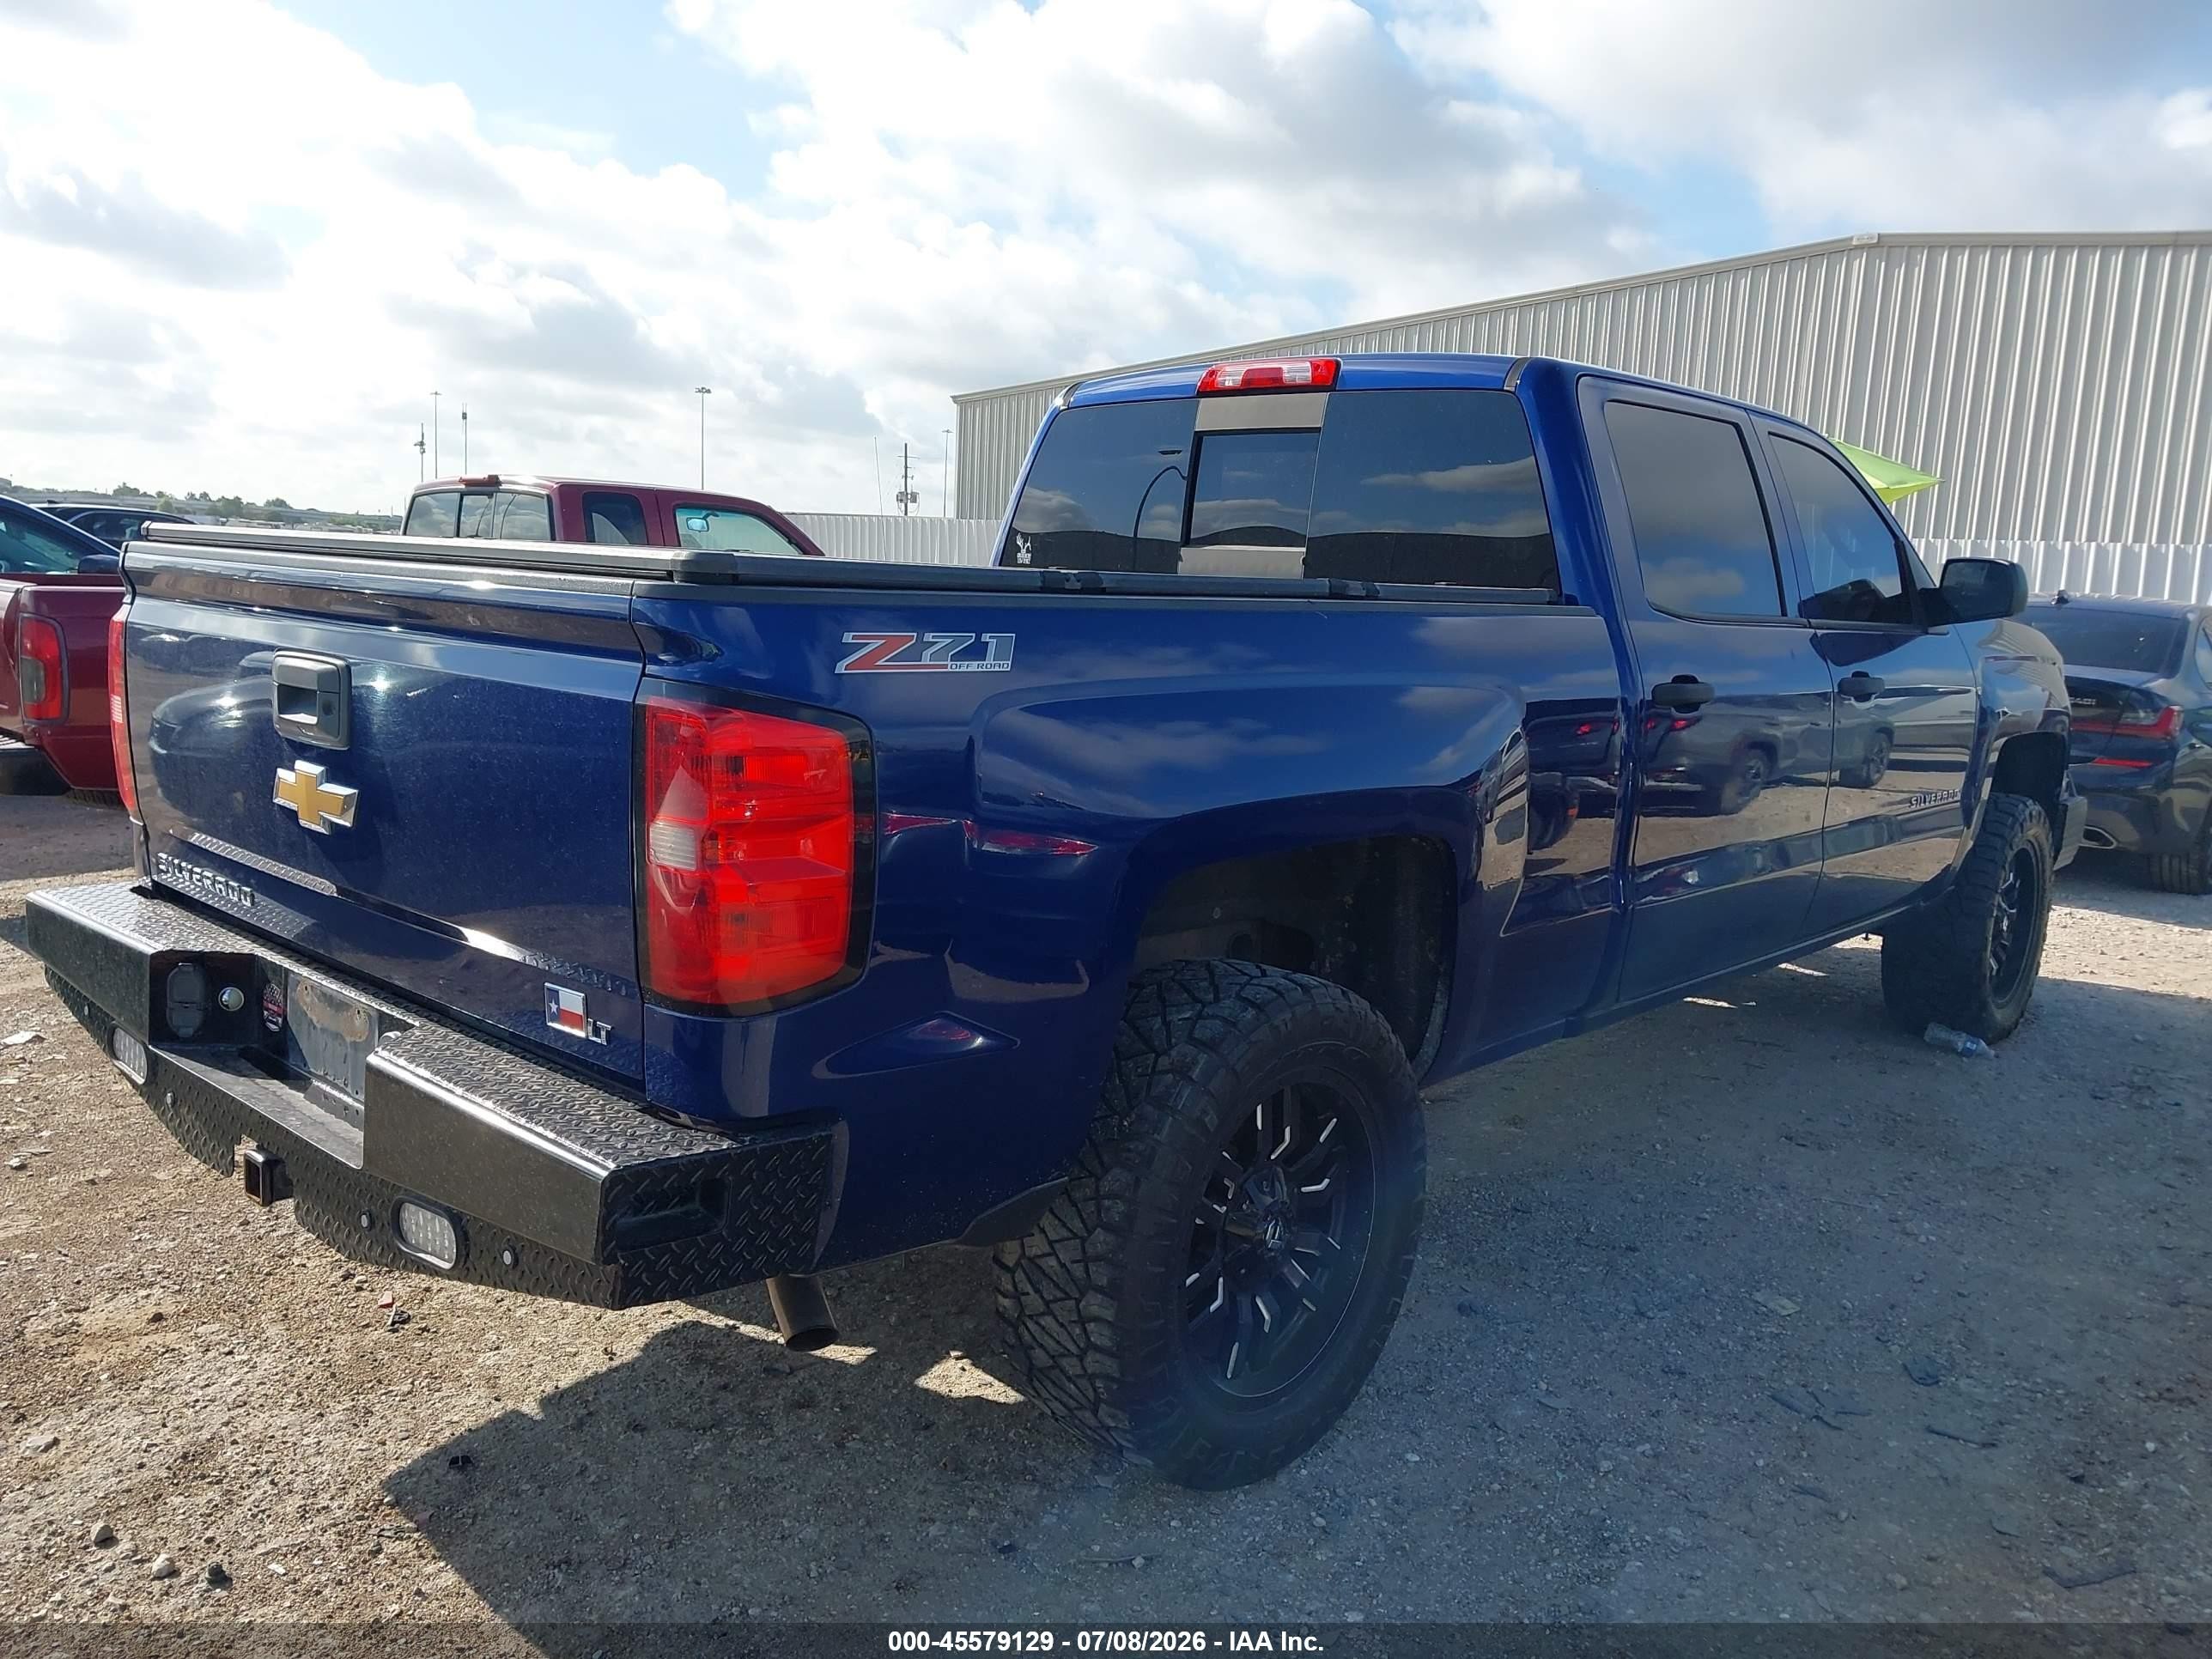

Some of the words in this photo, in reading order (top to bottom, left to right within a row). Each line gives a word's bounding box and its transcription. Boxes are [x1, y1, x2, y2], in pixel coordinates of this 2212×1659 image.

[834, 632, 1017, 674] Z71
[949, 662, 975, 671] OFF
[976, 661, 1011, 671] ROAD
[1910, 789, 1961, 809] SILVERADO
[157, 852, 256, 907] SILVERADO
[587, 1018, 612, 1046] LT
